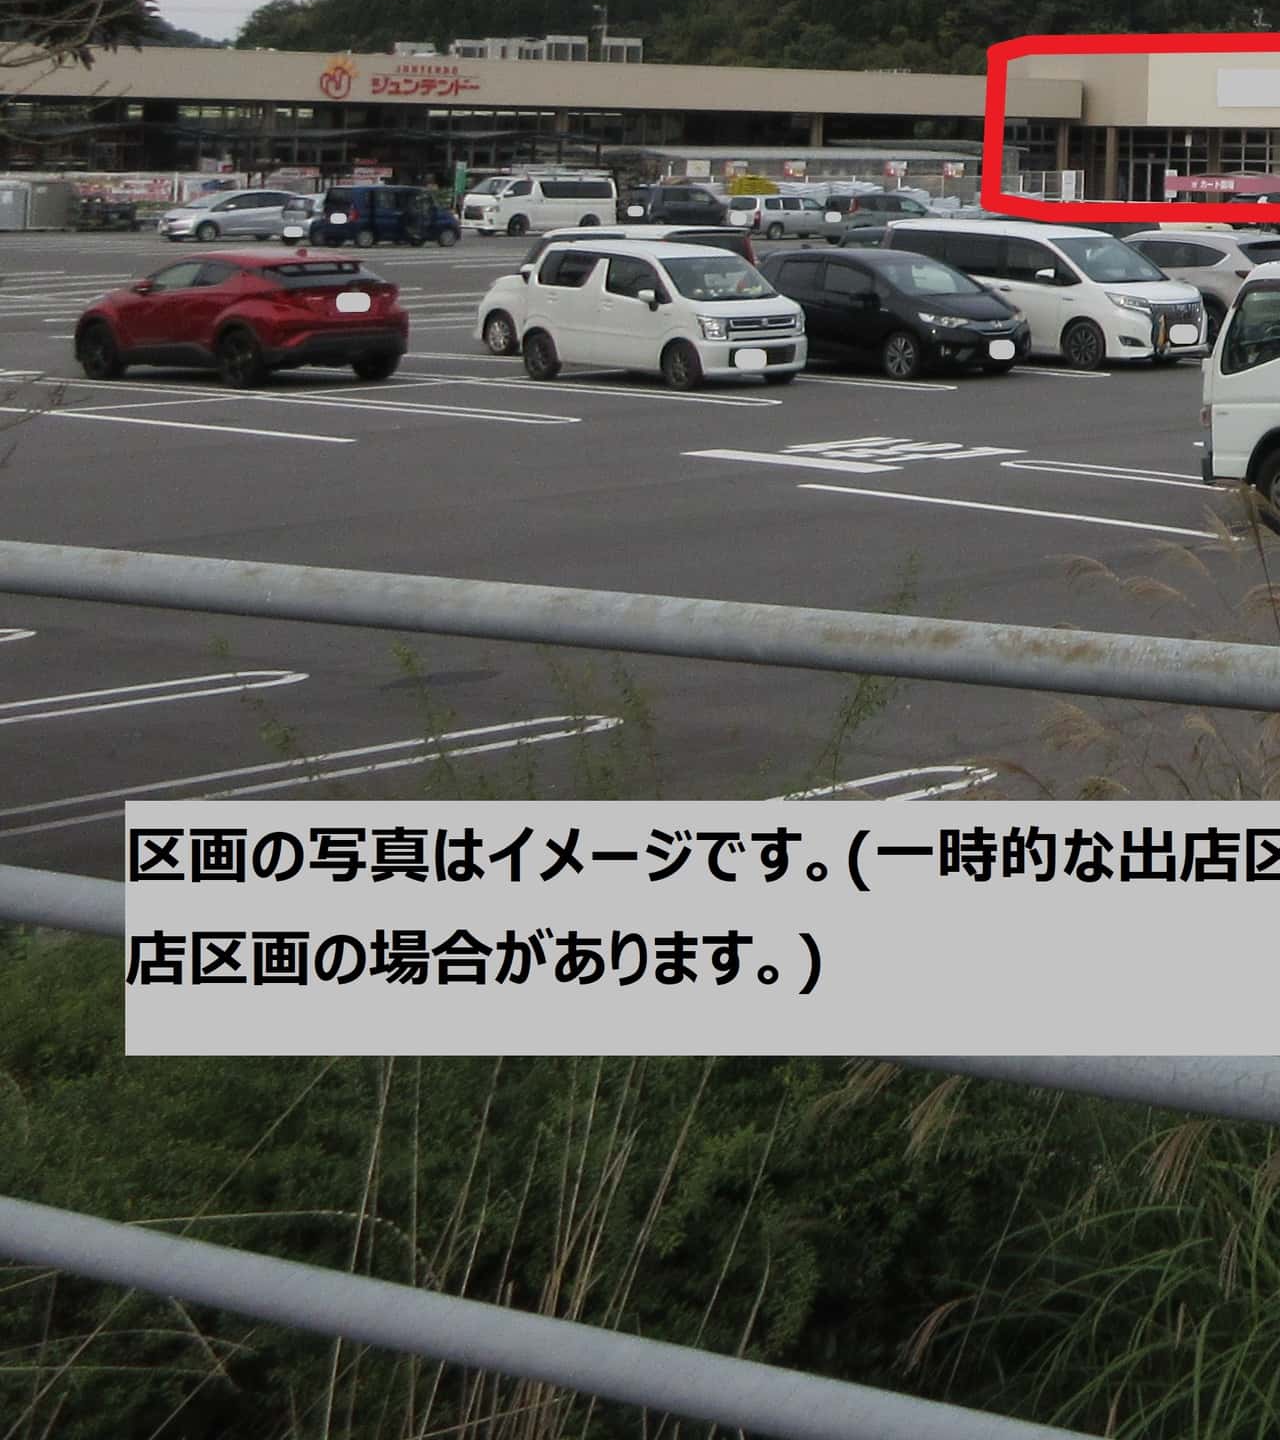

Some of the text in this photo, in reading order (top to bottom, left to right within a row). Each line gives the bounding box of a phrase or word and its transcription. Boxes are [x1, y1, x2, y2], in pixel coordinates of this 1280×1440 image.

[371, 77, 480, 96] ジュンテンドー
